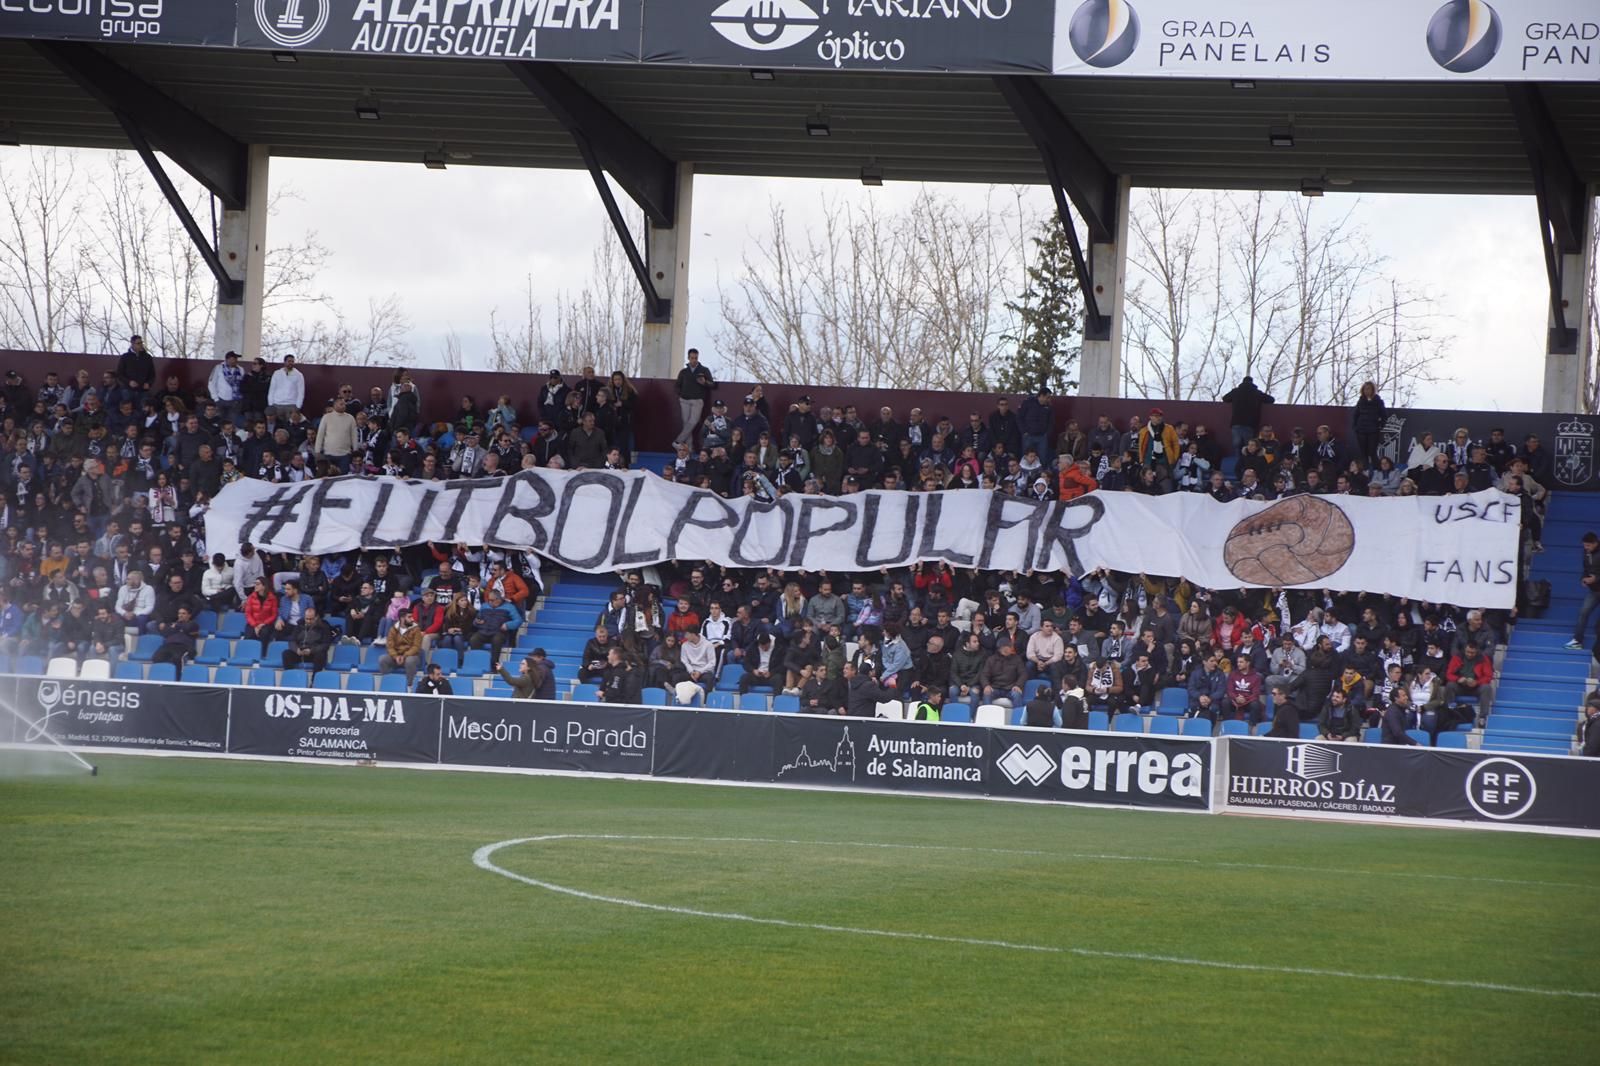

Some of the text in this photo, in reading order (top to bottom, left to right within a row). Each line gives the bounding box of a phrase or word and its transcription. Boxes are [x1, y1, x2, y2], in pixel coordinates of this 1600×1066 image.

[442, 0, 620, 30] PRIMERA
[101, 19, 160, 38] grupo
[351, 22, 537, 58] AUTOESCUELA
[1162, 20, 1255, 38] GRADA
[1525, 22, 1600, 40] GRAD
[816, 30, 906, 68] óptico
[1159, 42, 1331, 67] PANELAIS
[1522, 45, 1600, 71] PAN
[1434, 502, 1521, 525] USCF
[1423, 560, 1514, 585] FANS
[264, 693, 406, 724] OS-DA-MA
[120, 735, 137, 744] Santa
[157, 737, 165, 745] de
[299, 737, 368, 750] SALAMANCA
[448, 715, 647, 749] Mesón La Parada
[296, 748, 315, 757] Pintor
[867, 733, 983, 758] Ayuntamiento
[866, 757, 982, 782] de Salamanca
[1060, 745, 1203, 797] errea
[1231, 775, 1396, 803] HIERROS DÍAZ
[1230, 796, 1273, 806] SALAMANCA
[1279, 799, 1318, 809] PLASENCIA
[1363, 804, 1396, 814] BADAJOZ
